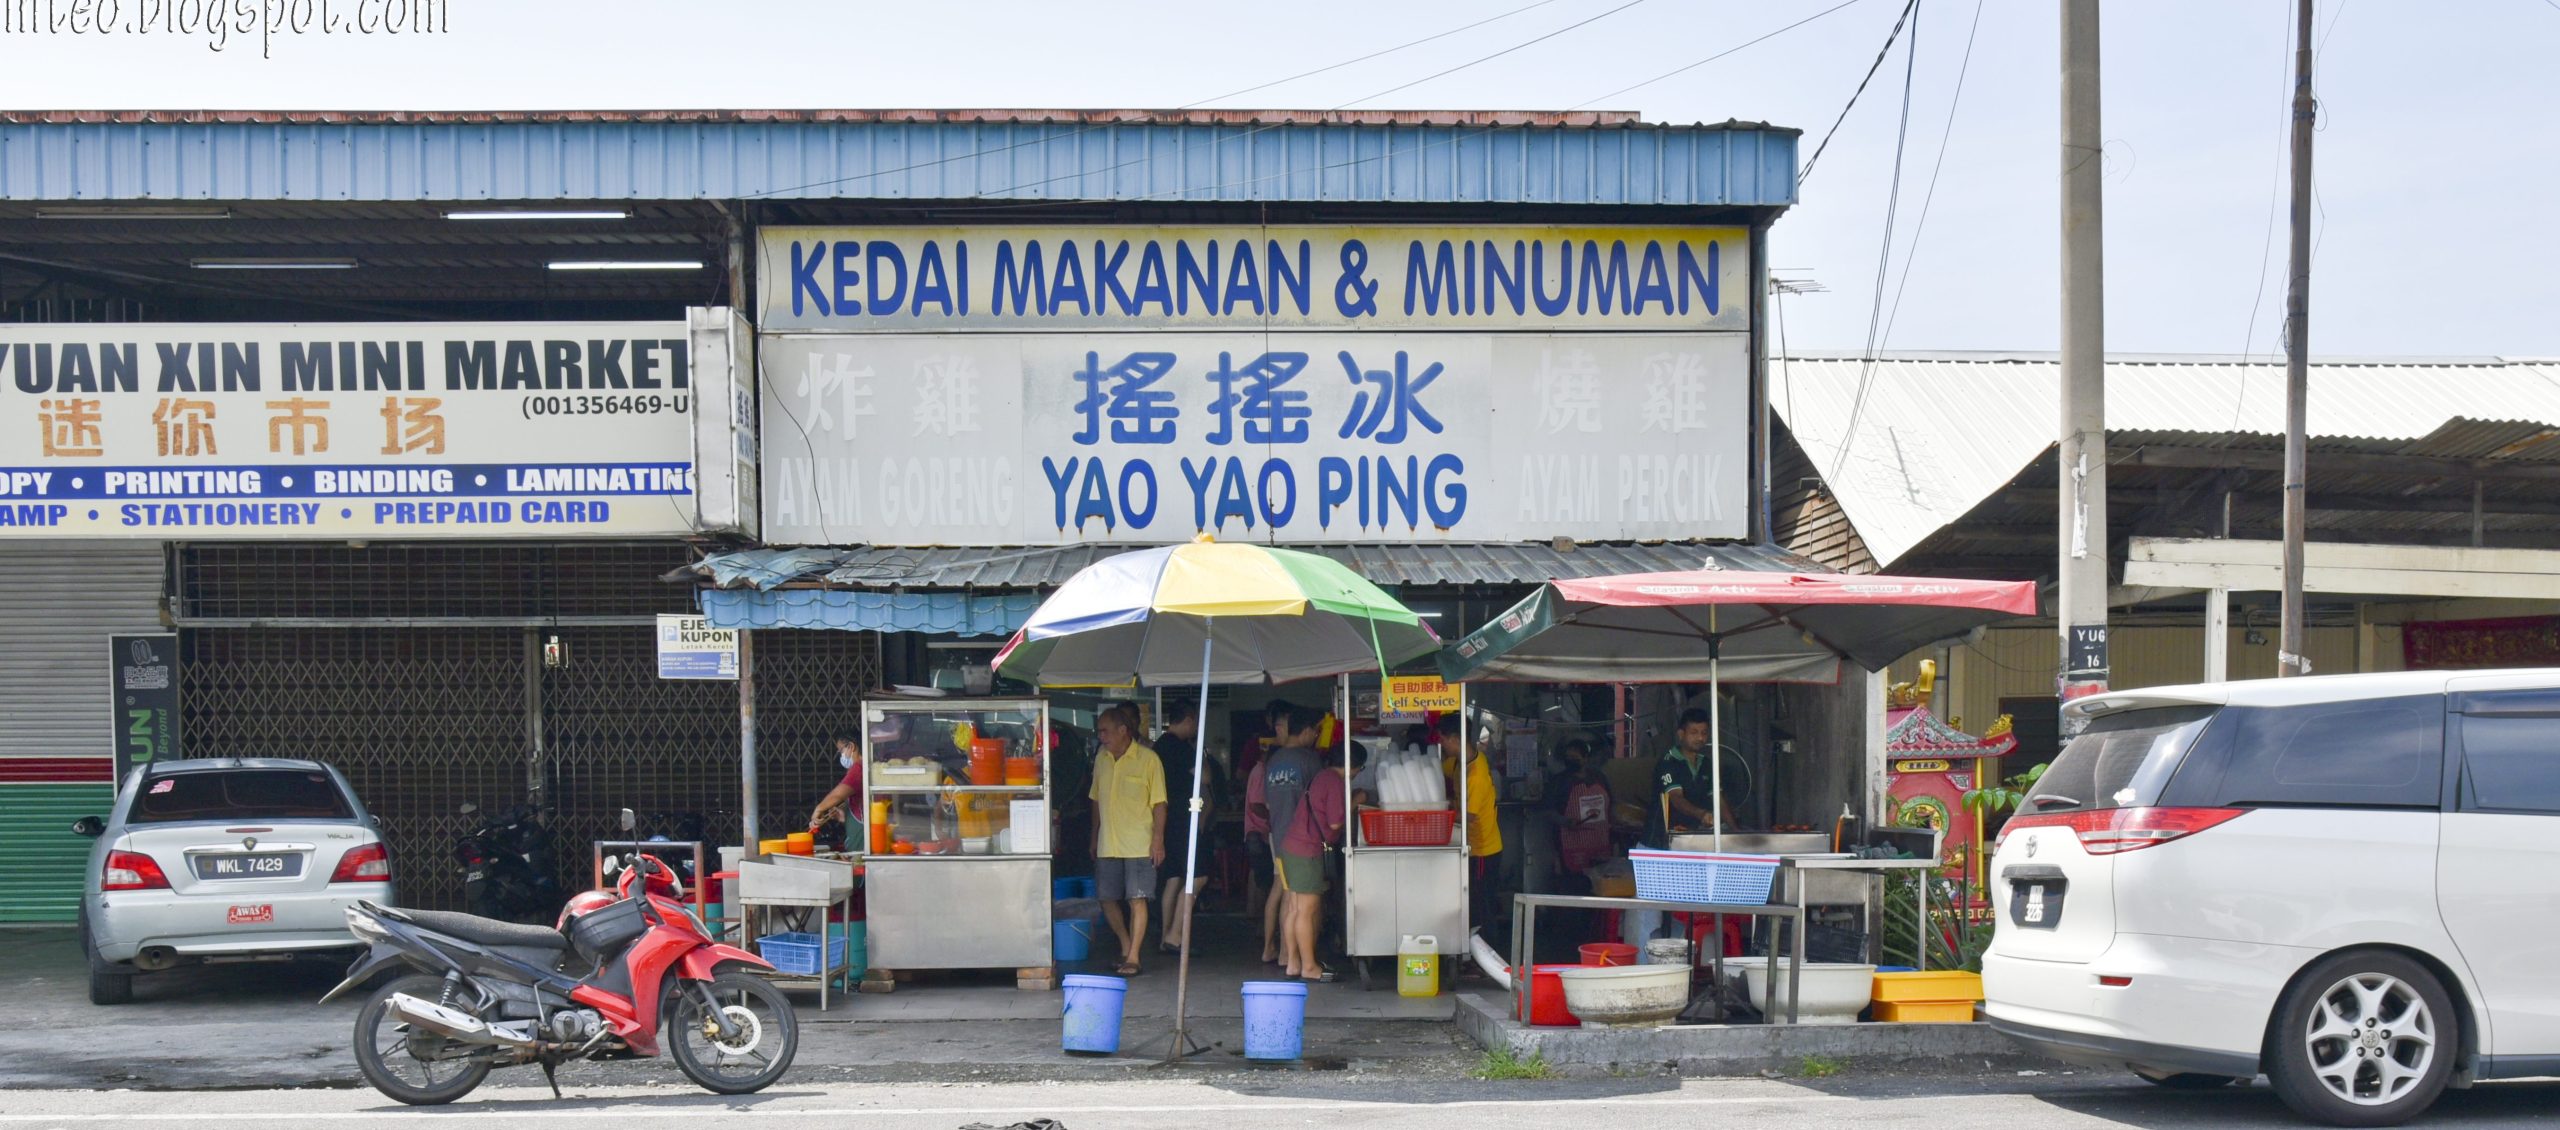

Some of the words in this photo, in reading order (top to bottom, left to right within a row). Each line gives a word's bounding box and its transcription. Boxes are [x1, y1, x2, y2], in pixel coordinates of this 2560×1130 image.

[791, 240, 969, 318] KEDAI
[991, 239, 1311, 317] MAKANAN
[1335, 239, 1379, 318] &
[1404, 240, 1719, 317] MINUMAN
[0, 343, 139, 394] UAN
[155, 342, 261, 392] XIN
[280, 341, 425, 392] MINI
[445, 339, 687, 391] MARKET
[1072, 350, 1445, 446] 搖搖冰
[38, 397, 446, 457] 迷你市场
[105, 470, 262, 494] PRINTING
[314, 469, 454, 493] BINDING
[776, 456, 863, 527] AYAM
[880, 456, 1014, 528] GORENG
[1041, 455, 1159, 530] YAO
[1180, 455, 1297, 530] YAO
[1318, 453, 1468, 530] PING
[1517, 454, 1600, 523] AYAM
[1617, 453, 1723, 523] PERCIK
[121, 503, 320, 526] STATIONERY
[375, 501, 512, 524] PREPAID
[521, 500, 610, 523] CARD
[681, 620, 716, 631] EJE
[681, 632, 733, 643] KUPON
[2087, 654, 2100, 668] 16
[1412, 695, 1456, 707] Service
[156, 707, 170, 753] Beyond
[216, 859, 243, 873] WKL
[248, 857, 283, 872] 7429
